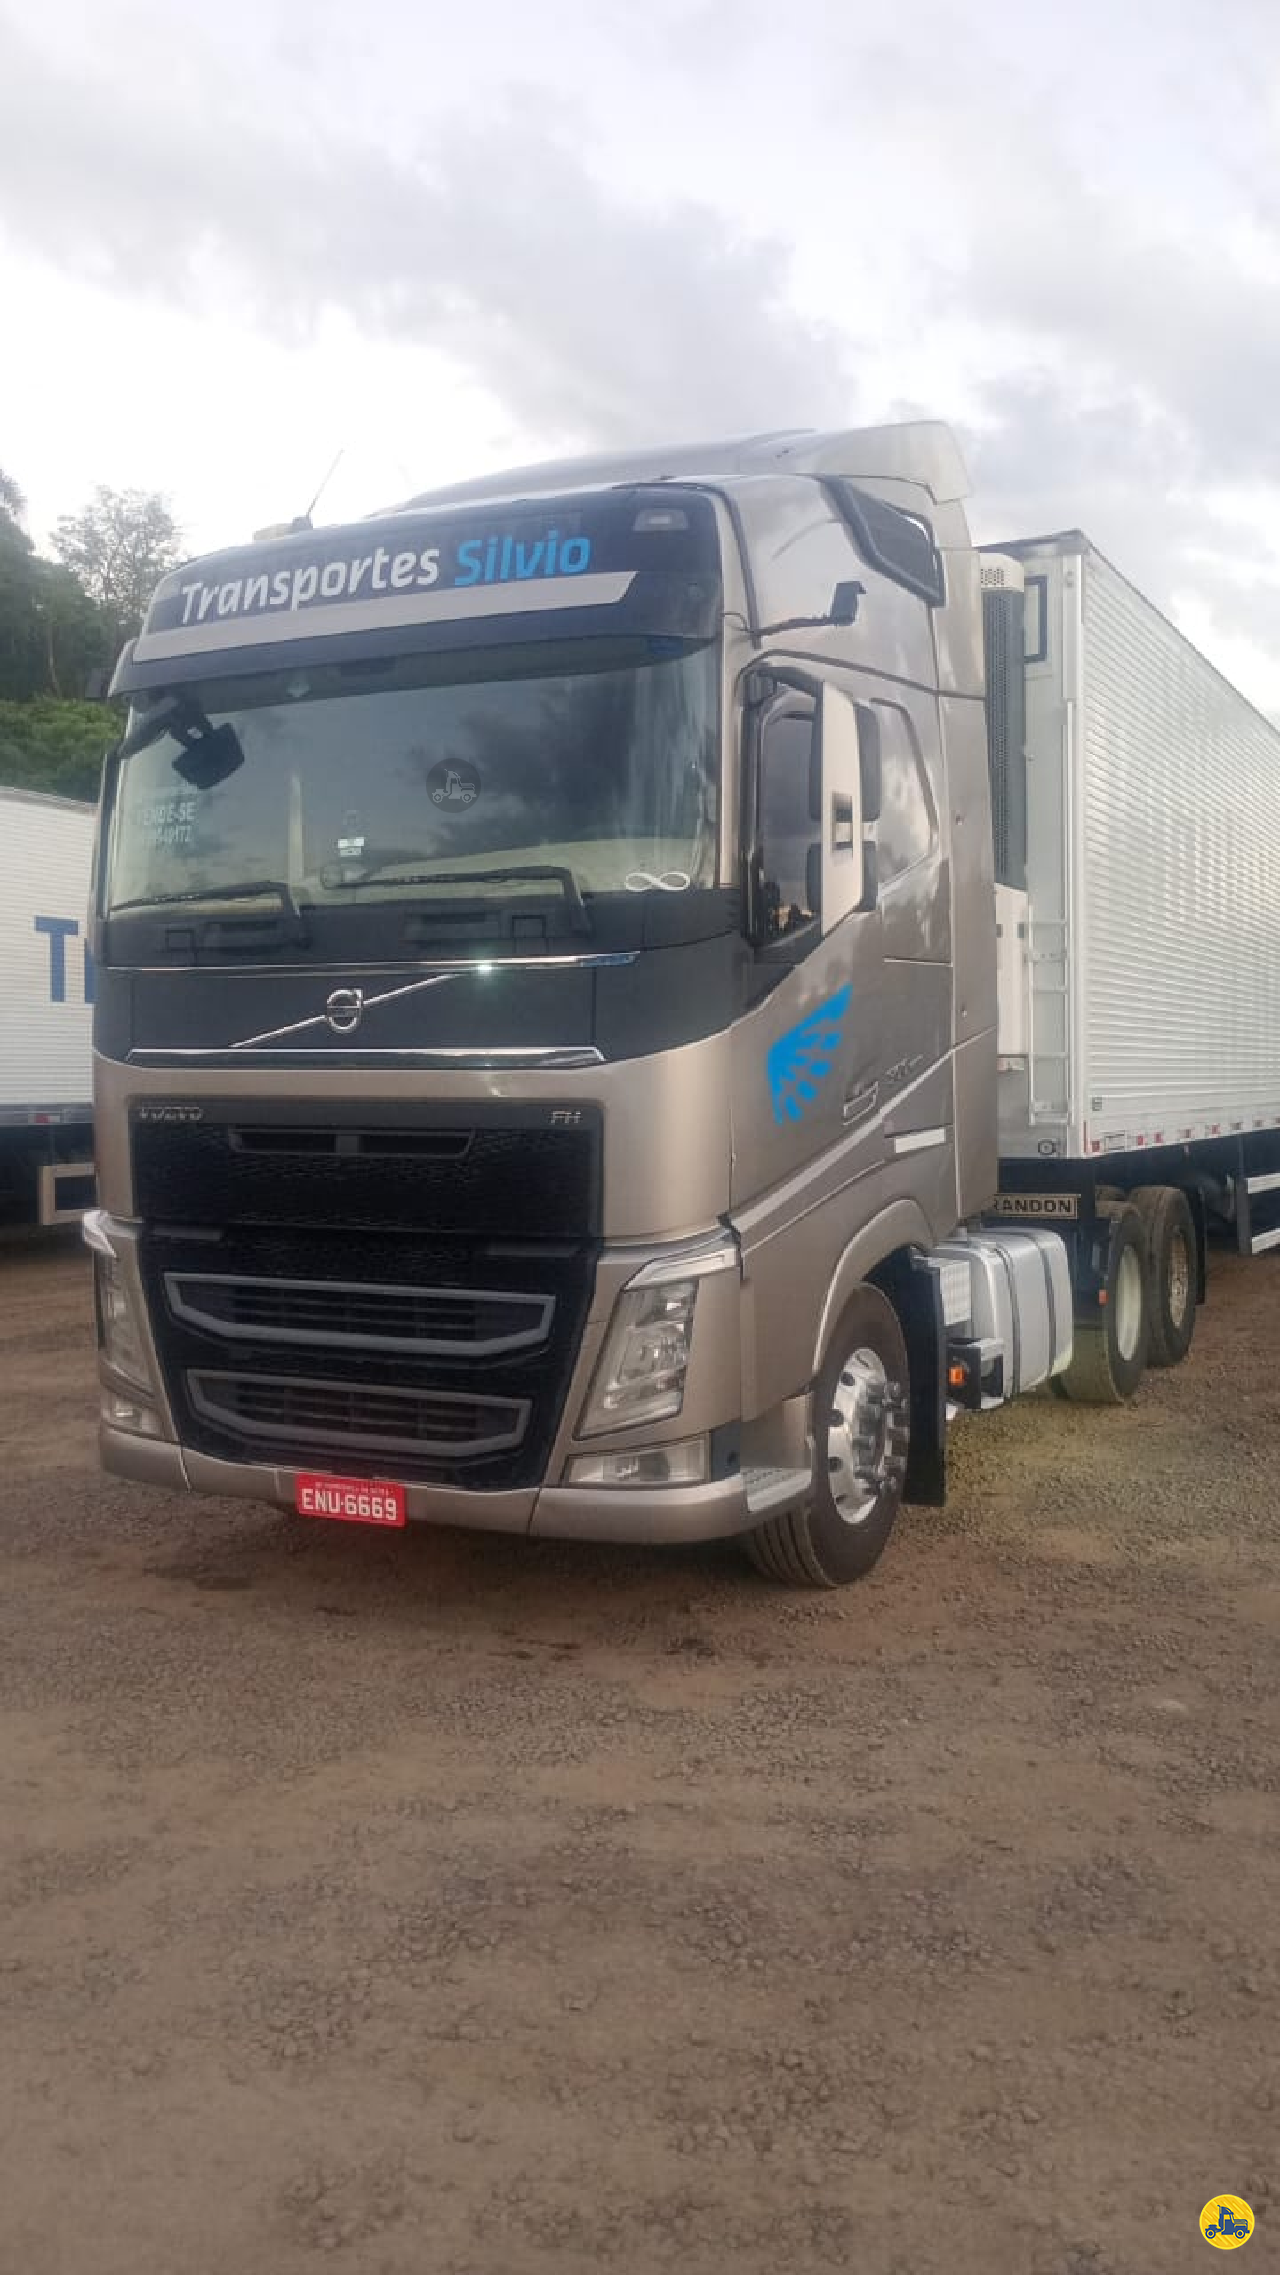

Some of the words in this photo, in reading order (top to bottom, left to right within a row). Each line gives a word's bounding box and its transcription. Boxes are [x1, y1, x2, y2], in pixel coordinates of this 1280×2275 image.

[181, 548, 440, 624] Transportes
[455, 531, 591, 585] Silvio
[551, 1110, 581, 1124] FH
